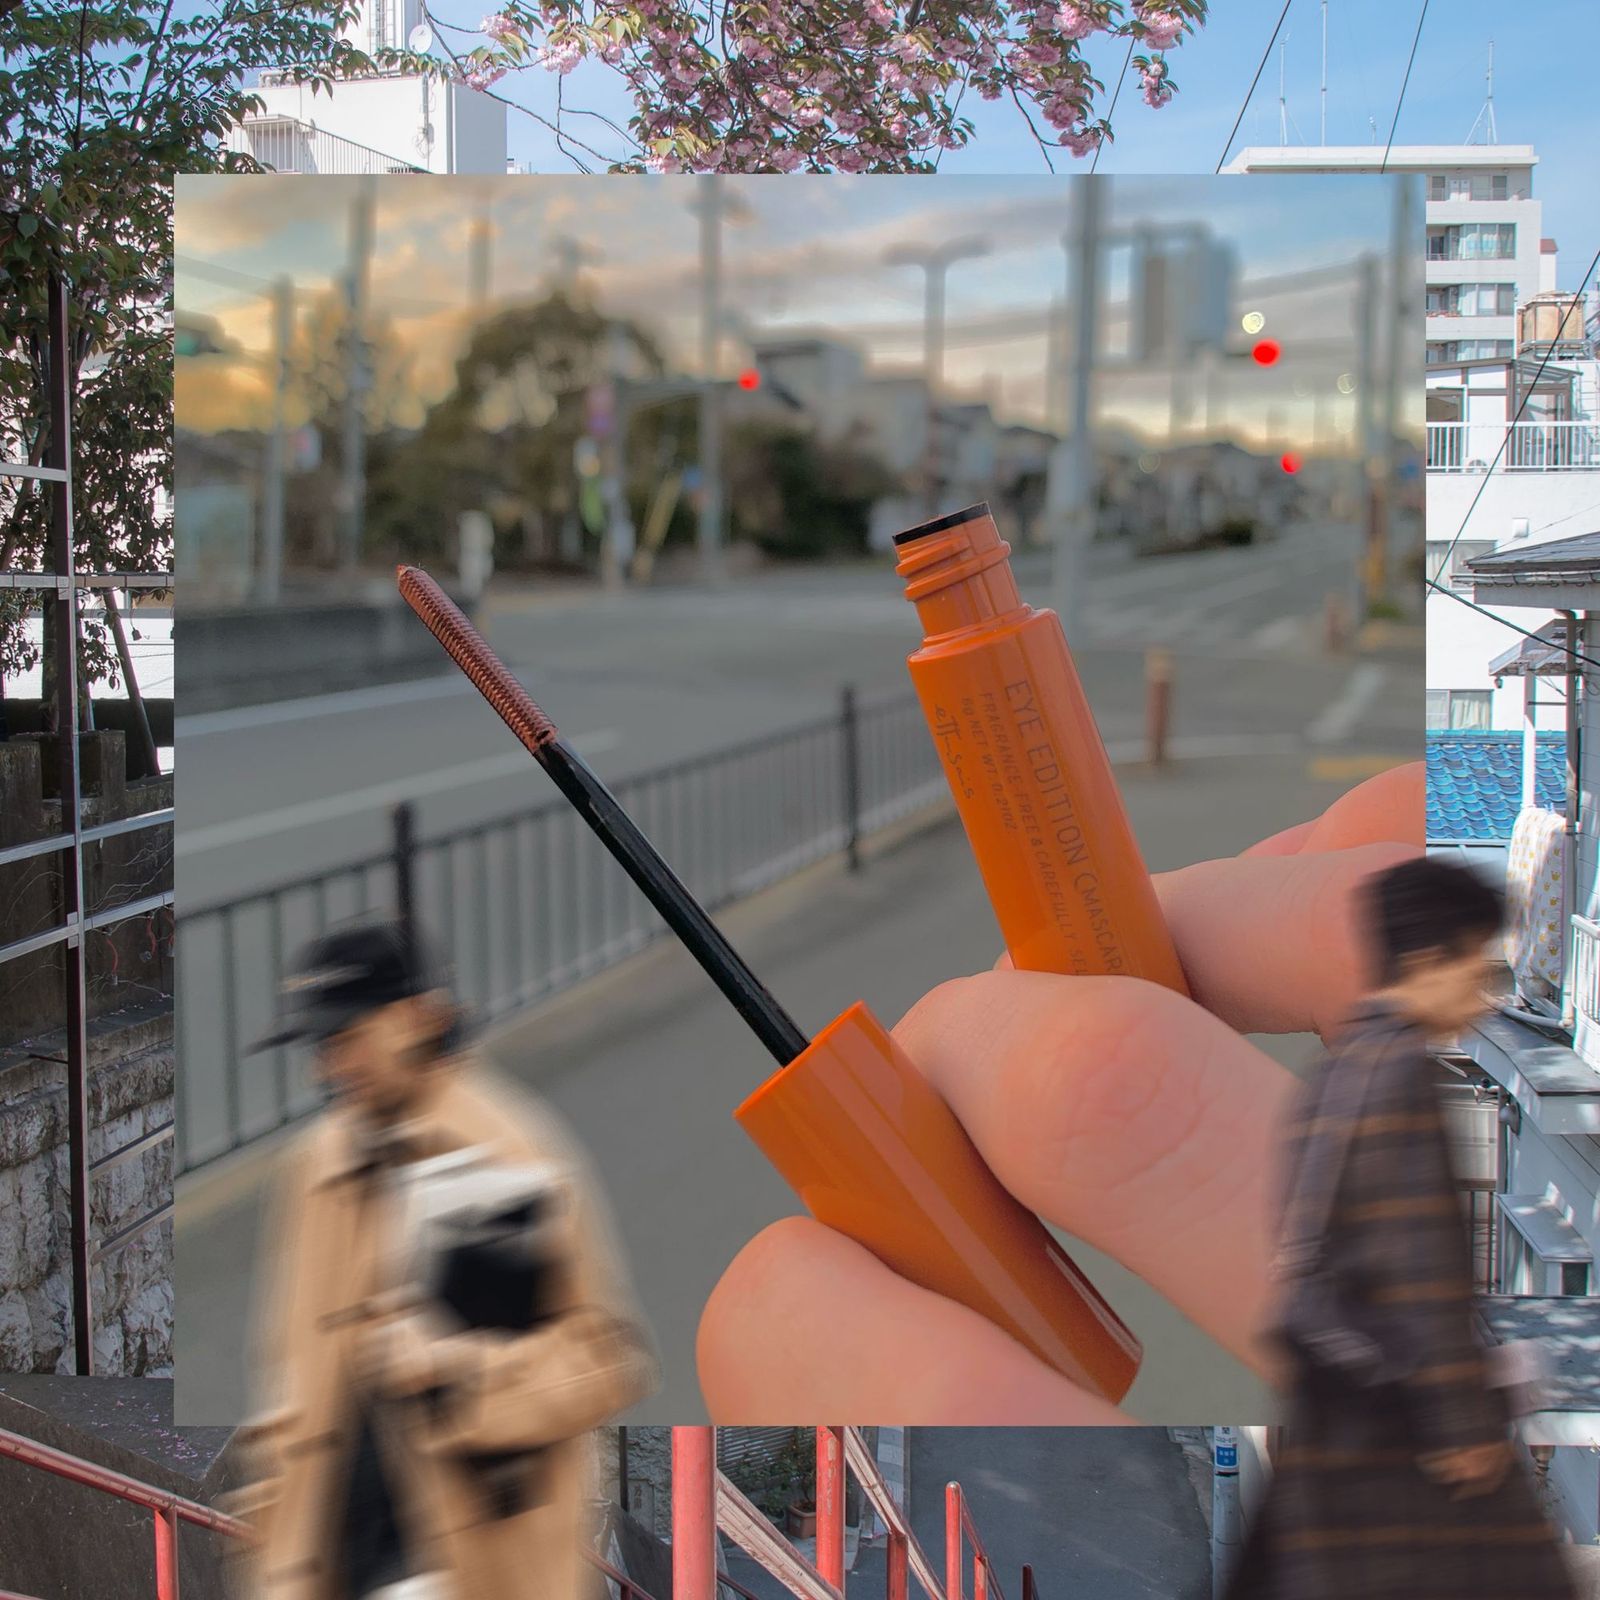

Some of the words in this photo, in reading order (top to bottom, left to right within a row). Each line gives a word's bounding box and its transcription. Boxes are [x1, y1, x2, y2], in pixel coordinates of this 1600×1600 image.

[969, 720, 989, 747] NET
[1003, 679, 1044, 740] EYE
[1026, 744, 1090, 867] EDITION
[1030, 838, 1044, 848] &
[1034, 851, 1078, 940] CAREFULLY
